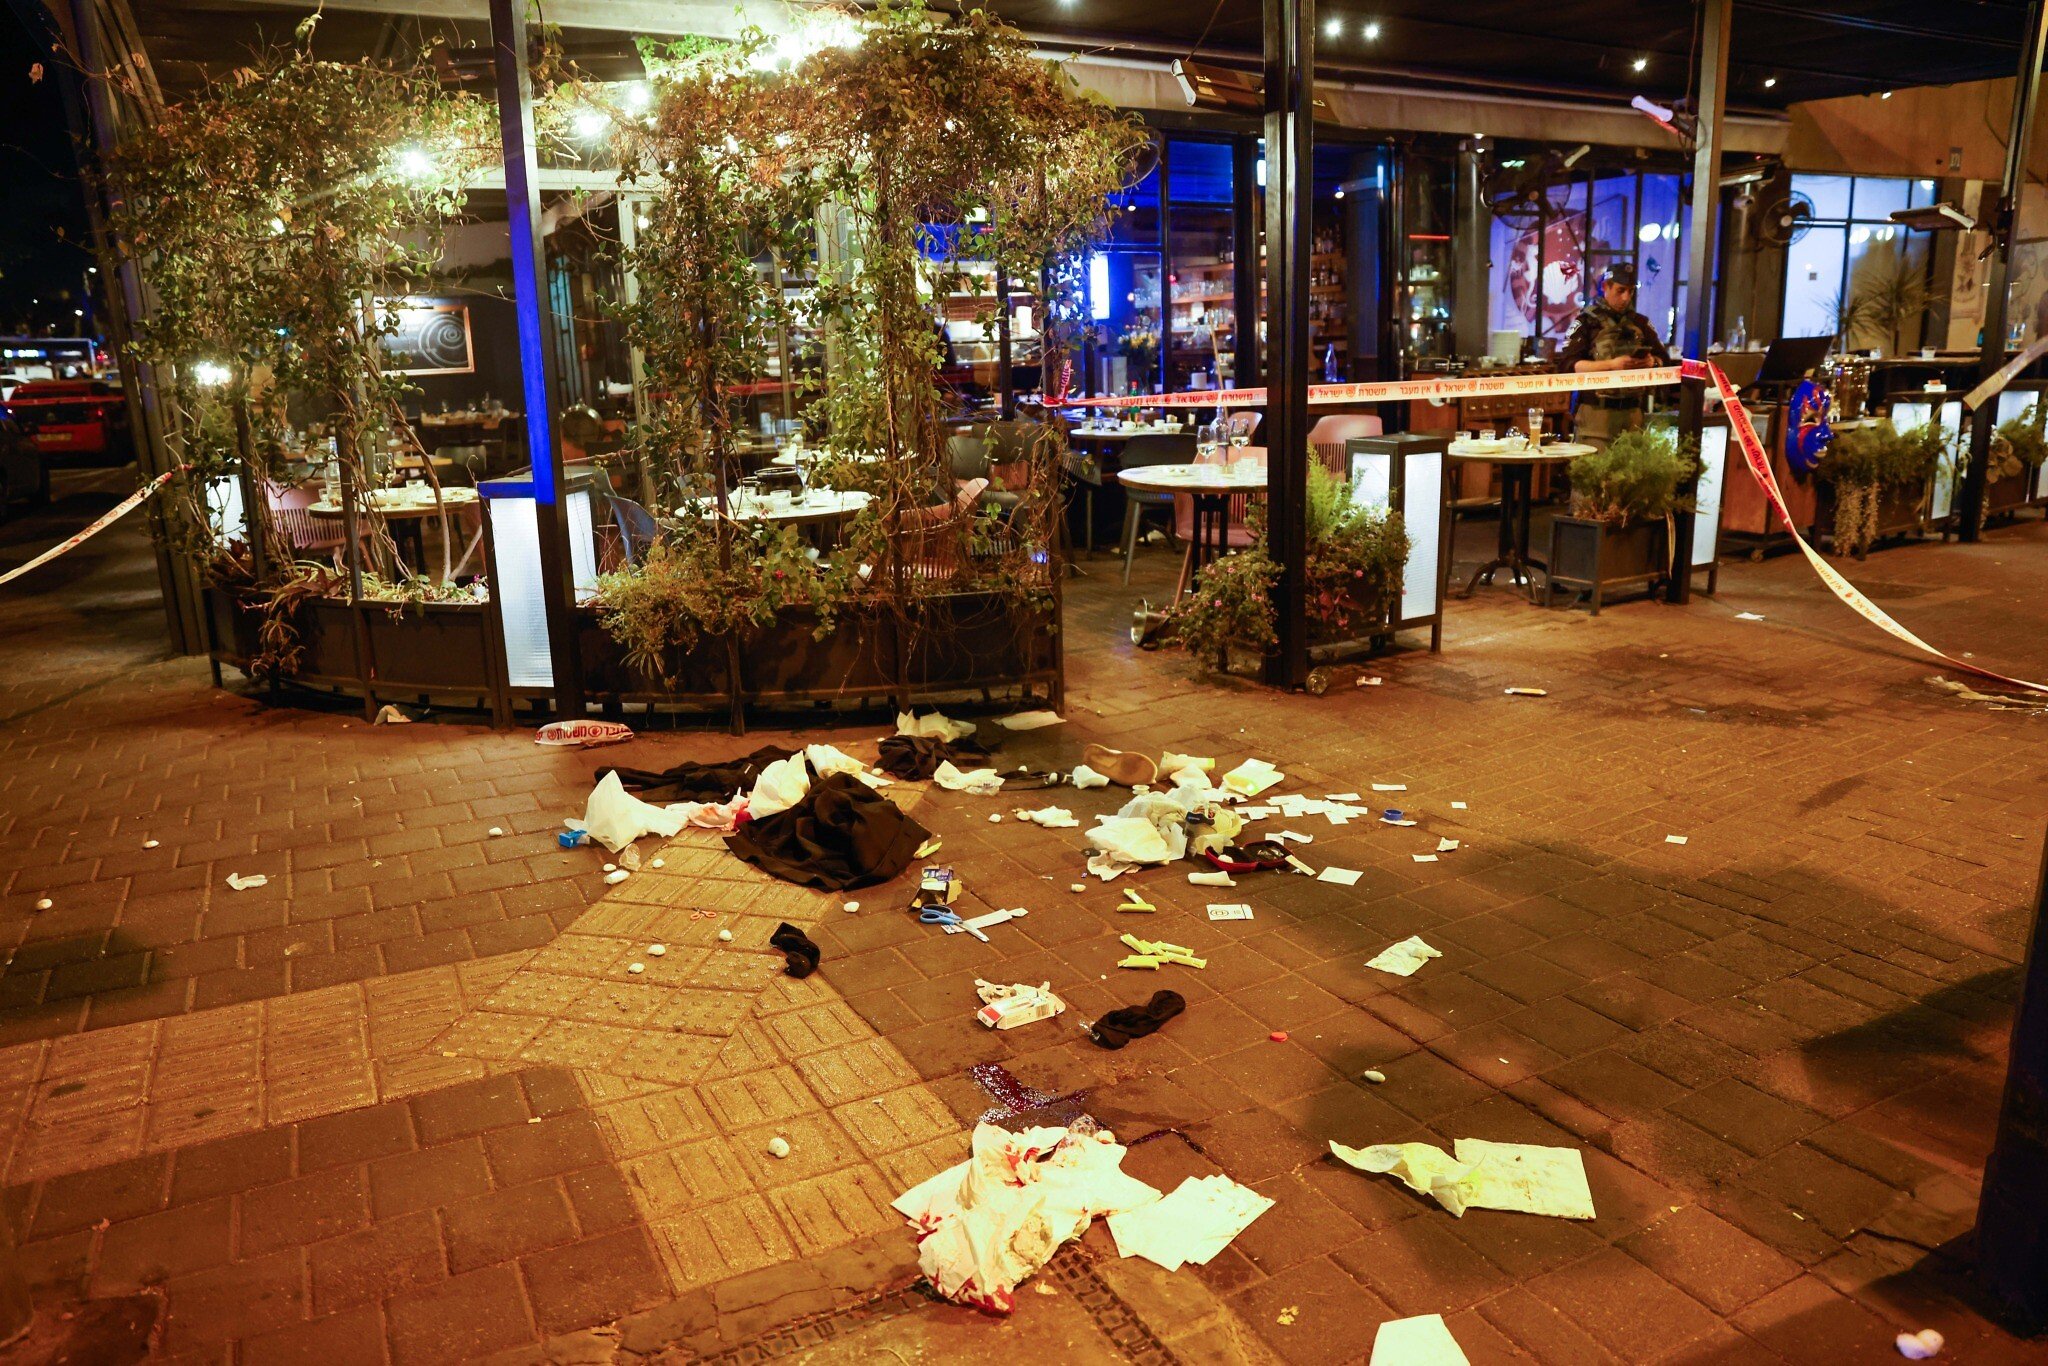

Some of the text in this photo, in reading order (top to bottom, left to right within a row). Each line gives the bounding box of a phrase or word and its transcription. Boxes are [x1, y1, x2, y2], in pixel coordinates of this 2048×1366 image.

[1587, 376, 1610, 384] משטרת
[1655, 371, 1673, 380] ישראל
[1556, 377, 1574, 386] ישראל
[1318, 388, 1387, 398] משטרת ישראל
[1399, 382, 1504, 395] משטרת ישראל אין מעבר
